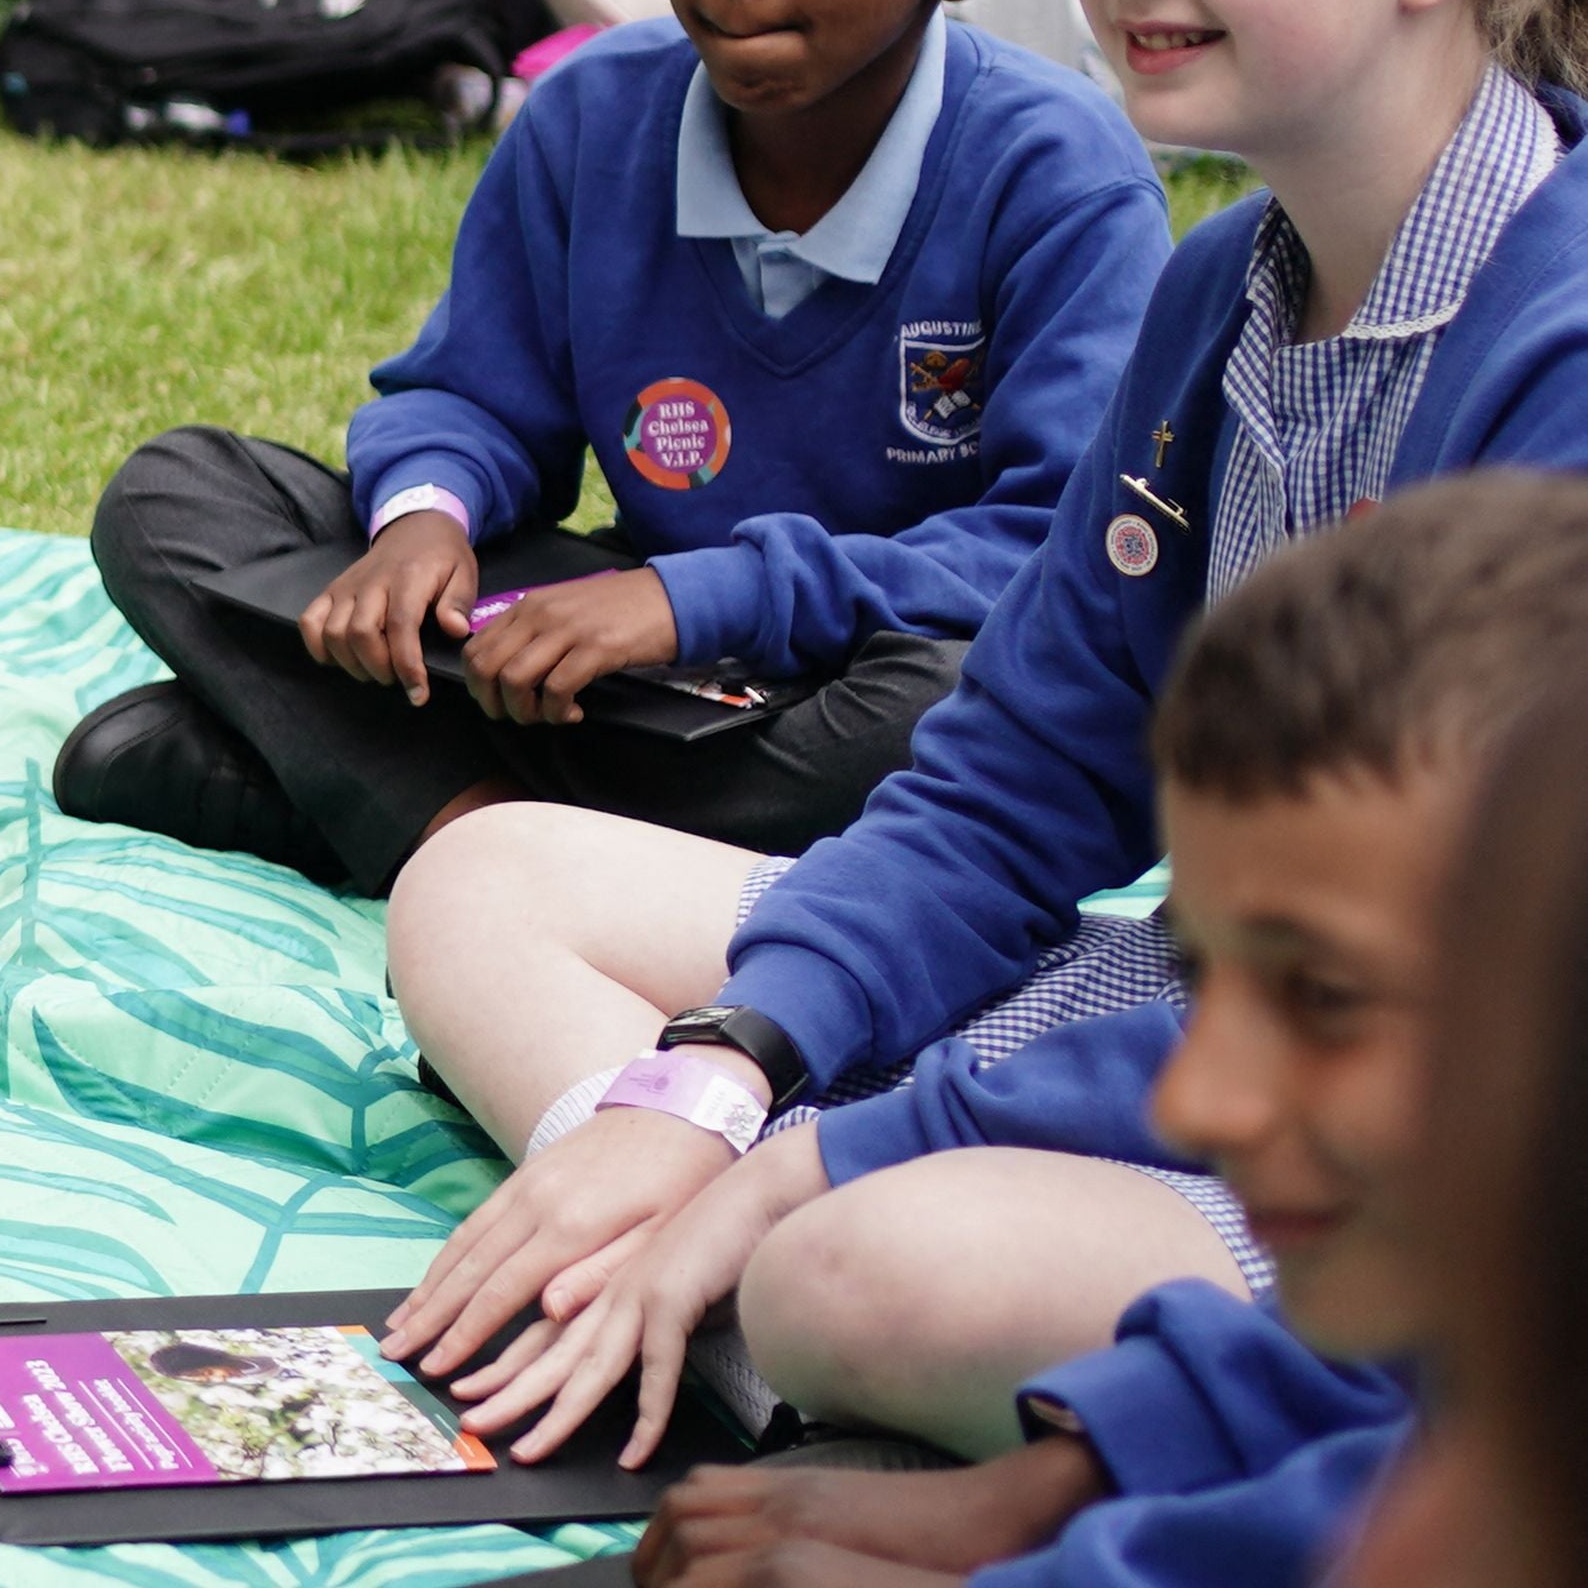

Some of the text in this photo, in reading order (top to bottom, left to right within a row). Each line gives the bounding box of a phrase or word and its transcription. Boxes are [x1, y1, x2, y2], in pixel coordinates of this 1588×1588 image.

[659, 400, 696, 419] RHS
[648, 418, 709, 437] Chelsea
[656, 434, 705, 452] Picnic
[662, 451, 704, 467] V.I.P.
[886, 445, 956, 465] PRIMARY
[22, 1393, 74, 1444] Chelsea
[25, 1359, 134, 1472] Flower Show 2023
